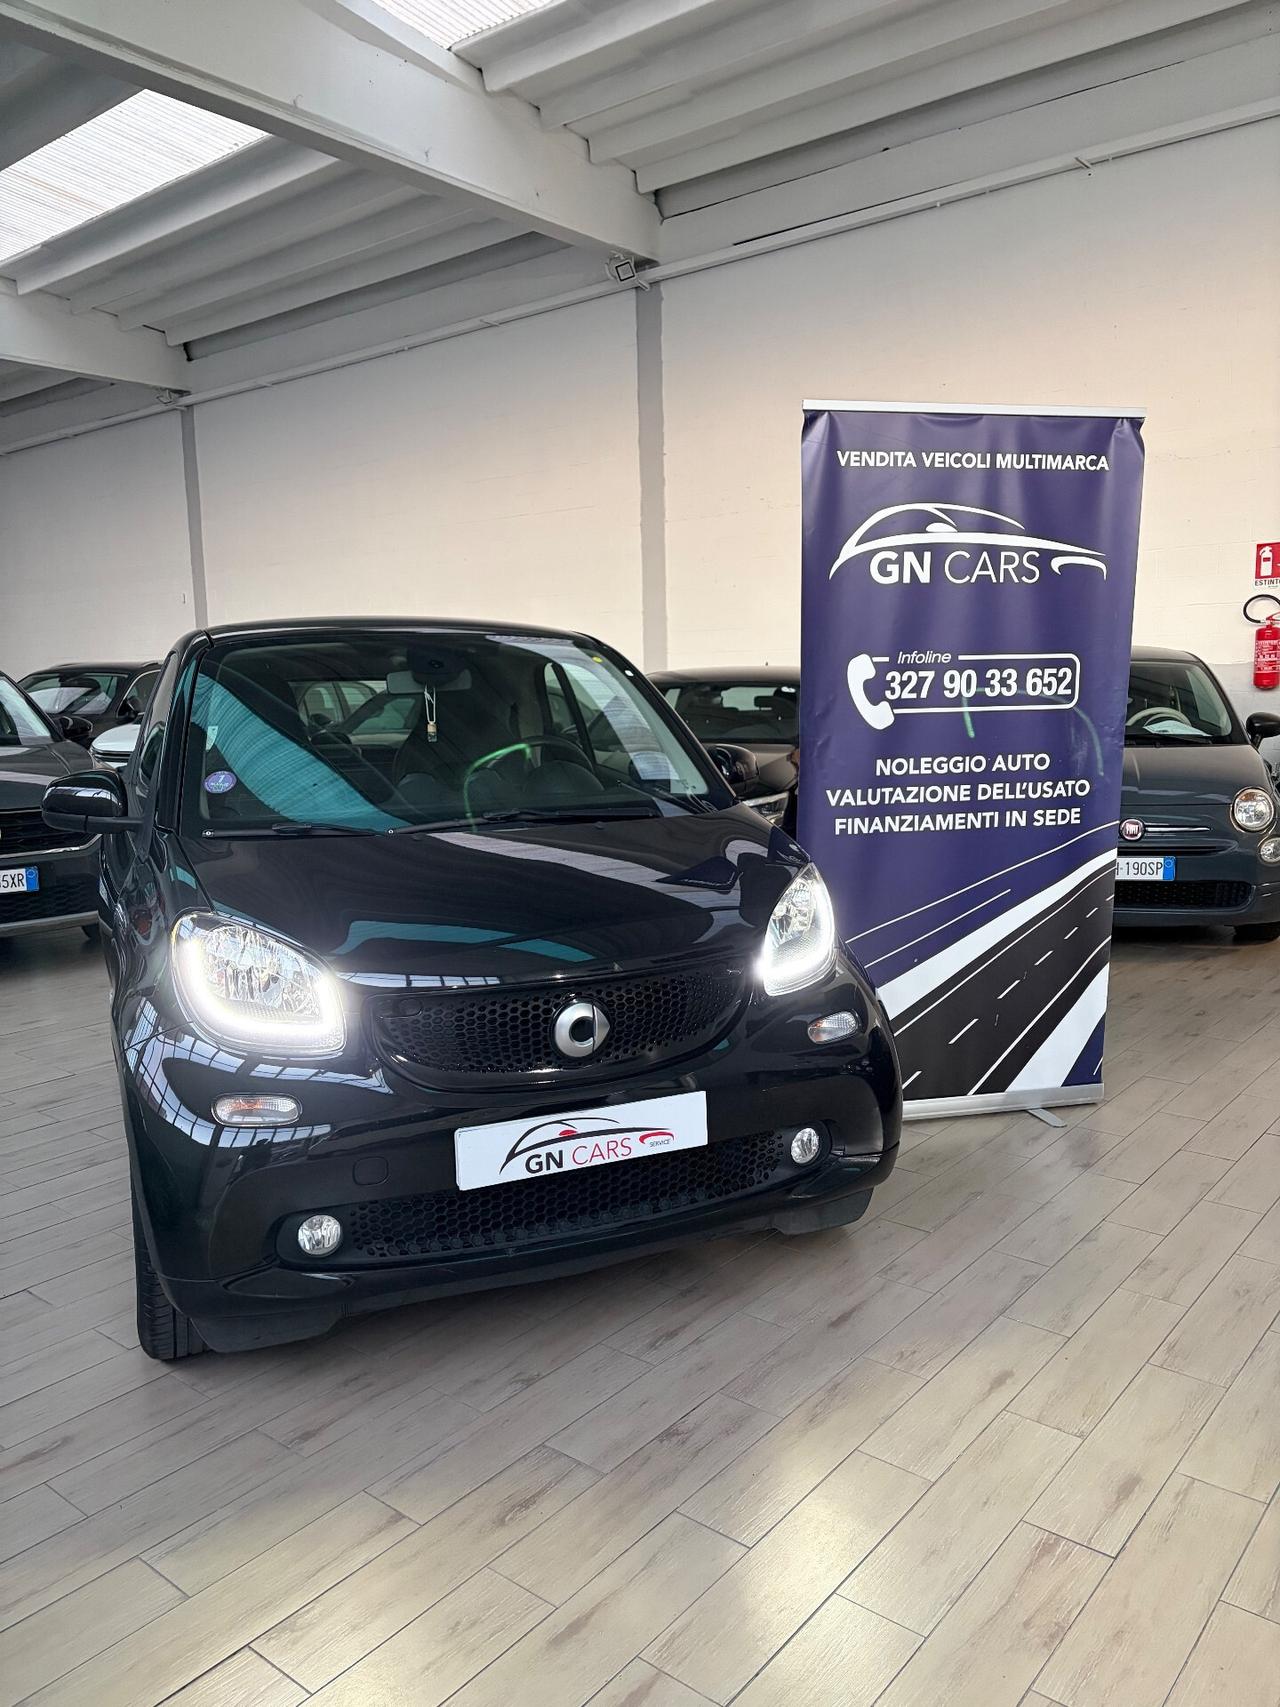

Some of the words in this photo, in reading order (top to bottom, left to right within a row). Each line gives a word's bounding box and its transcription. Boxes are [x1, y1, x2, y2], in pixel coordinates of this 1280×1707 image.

[837, 450, 917, 468] VENDITA
[921, 452, 991, 469] VEICOLI
[995, 453, 1110, 471] MULTIMARCA
[869, 551, 932, 584] GN
[943, 550, 1041, 585] CARS
[897, 650, 952, 665] Infoline
[884, 669, 936, 700] 327
[943, 669, 978, 699] 90
[984, 668, 1018, 698] 33
[1025, 667, 1073, 696] 652
[875, 755, 987, 777] NOLEGGIO
[991, 752, 1051, 772] AUTO
[825, 785, 971, 807] VALUTAZIONE
[834, 812, 999, 835] FINANZIAMENTI
[1005, 811, 1027, 827] IN
[1032, 808, 1081, 826] SEDE
[525, 1149, 564, 1174] GN
[572, 1138, 632, 1166] CARS
